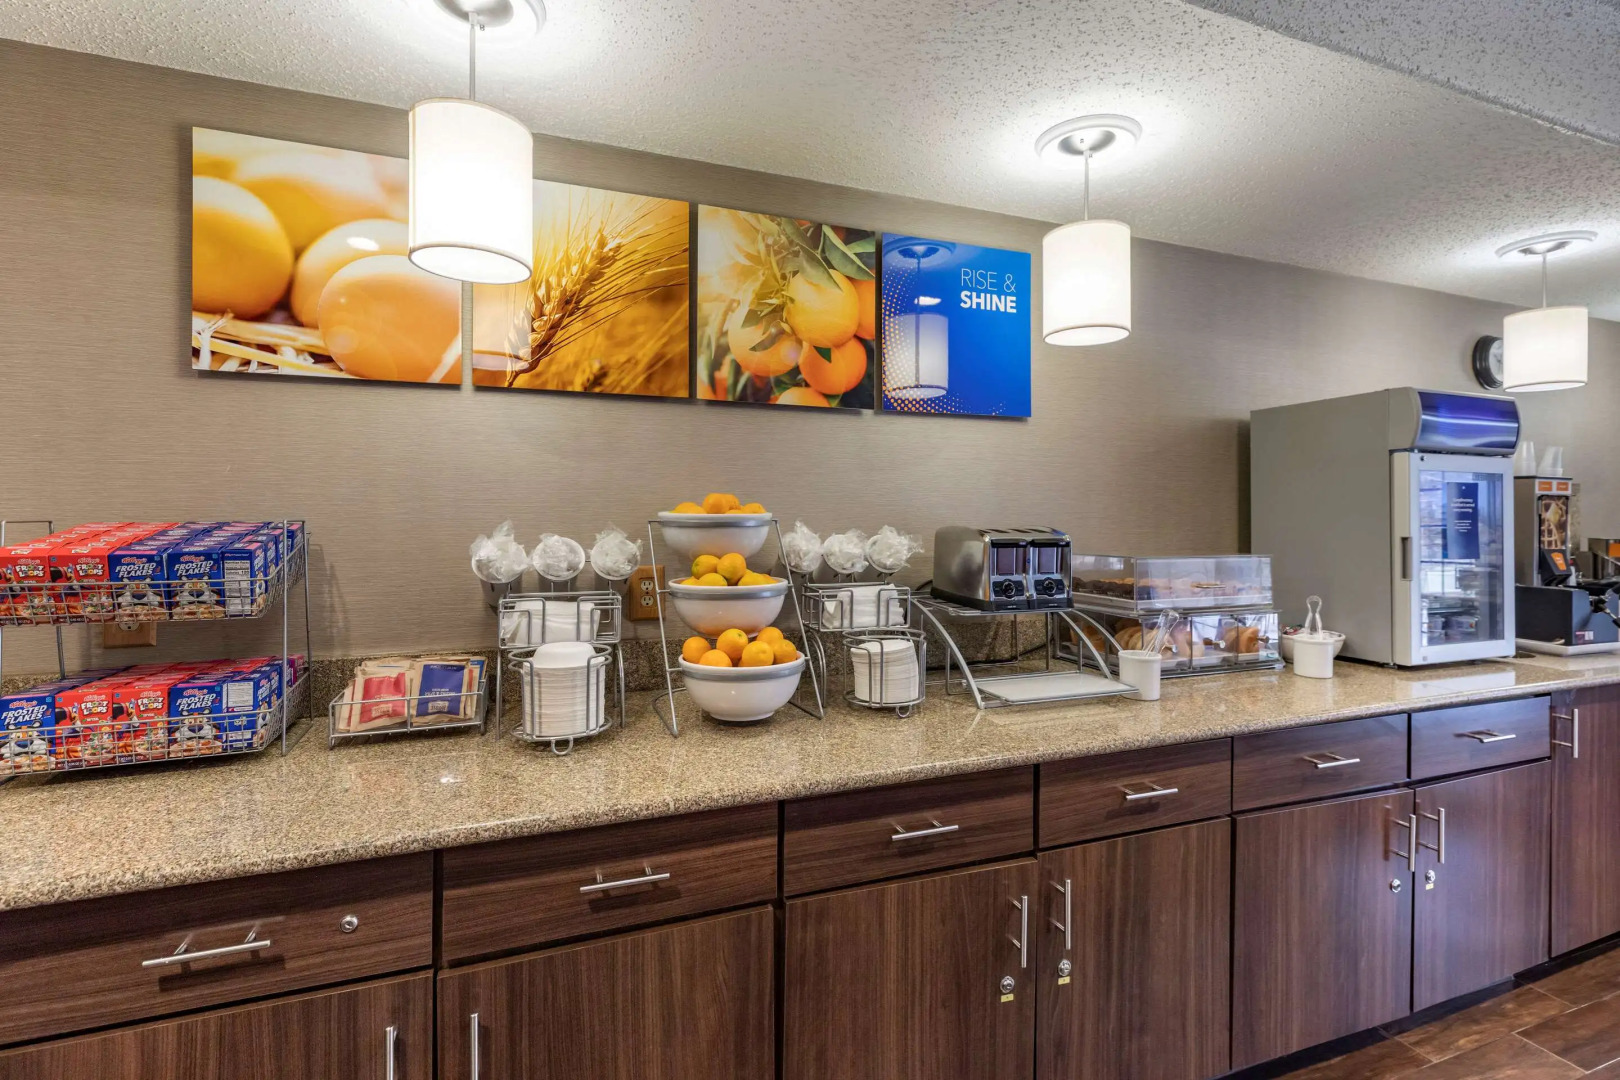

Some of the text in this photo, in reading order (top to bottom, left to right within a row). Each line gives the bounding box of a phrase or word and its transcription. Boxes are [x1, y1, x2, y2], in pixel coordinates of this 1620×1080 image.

[961, 268, 1017, 293] RISE &
[960, 290, 1017, 313] SHINE
[15, 564, 44, 573] FROOT
[75, 564, 104, 572] FROOT
[115, 562, 156, 573] FROSTED
[174, 560, 214, 571] FROSTED
[18, 570, 44, 578] LOOPS
[79, 569, 104, 577] LOOPS
[118, 569, 154, 578] FLAKES
[177, 567, 211, 576] FLAKES
[137, 697, 164, 705] FROOT
[176, 693, 216, 706] FROSTED
[81, 701, 109, 709] FROOT
[140, 702, 163, 711] LOOPS
[178, 700, 213, 711] FLAKES
[1, 705, 47, 720] FROSTED
[83, 706, 108, 715] LOOPS
[4, 712, 43, 725] FLAKES
